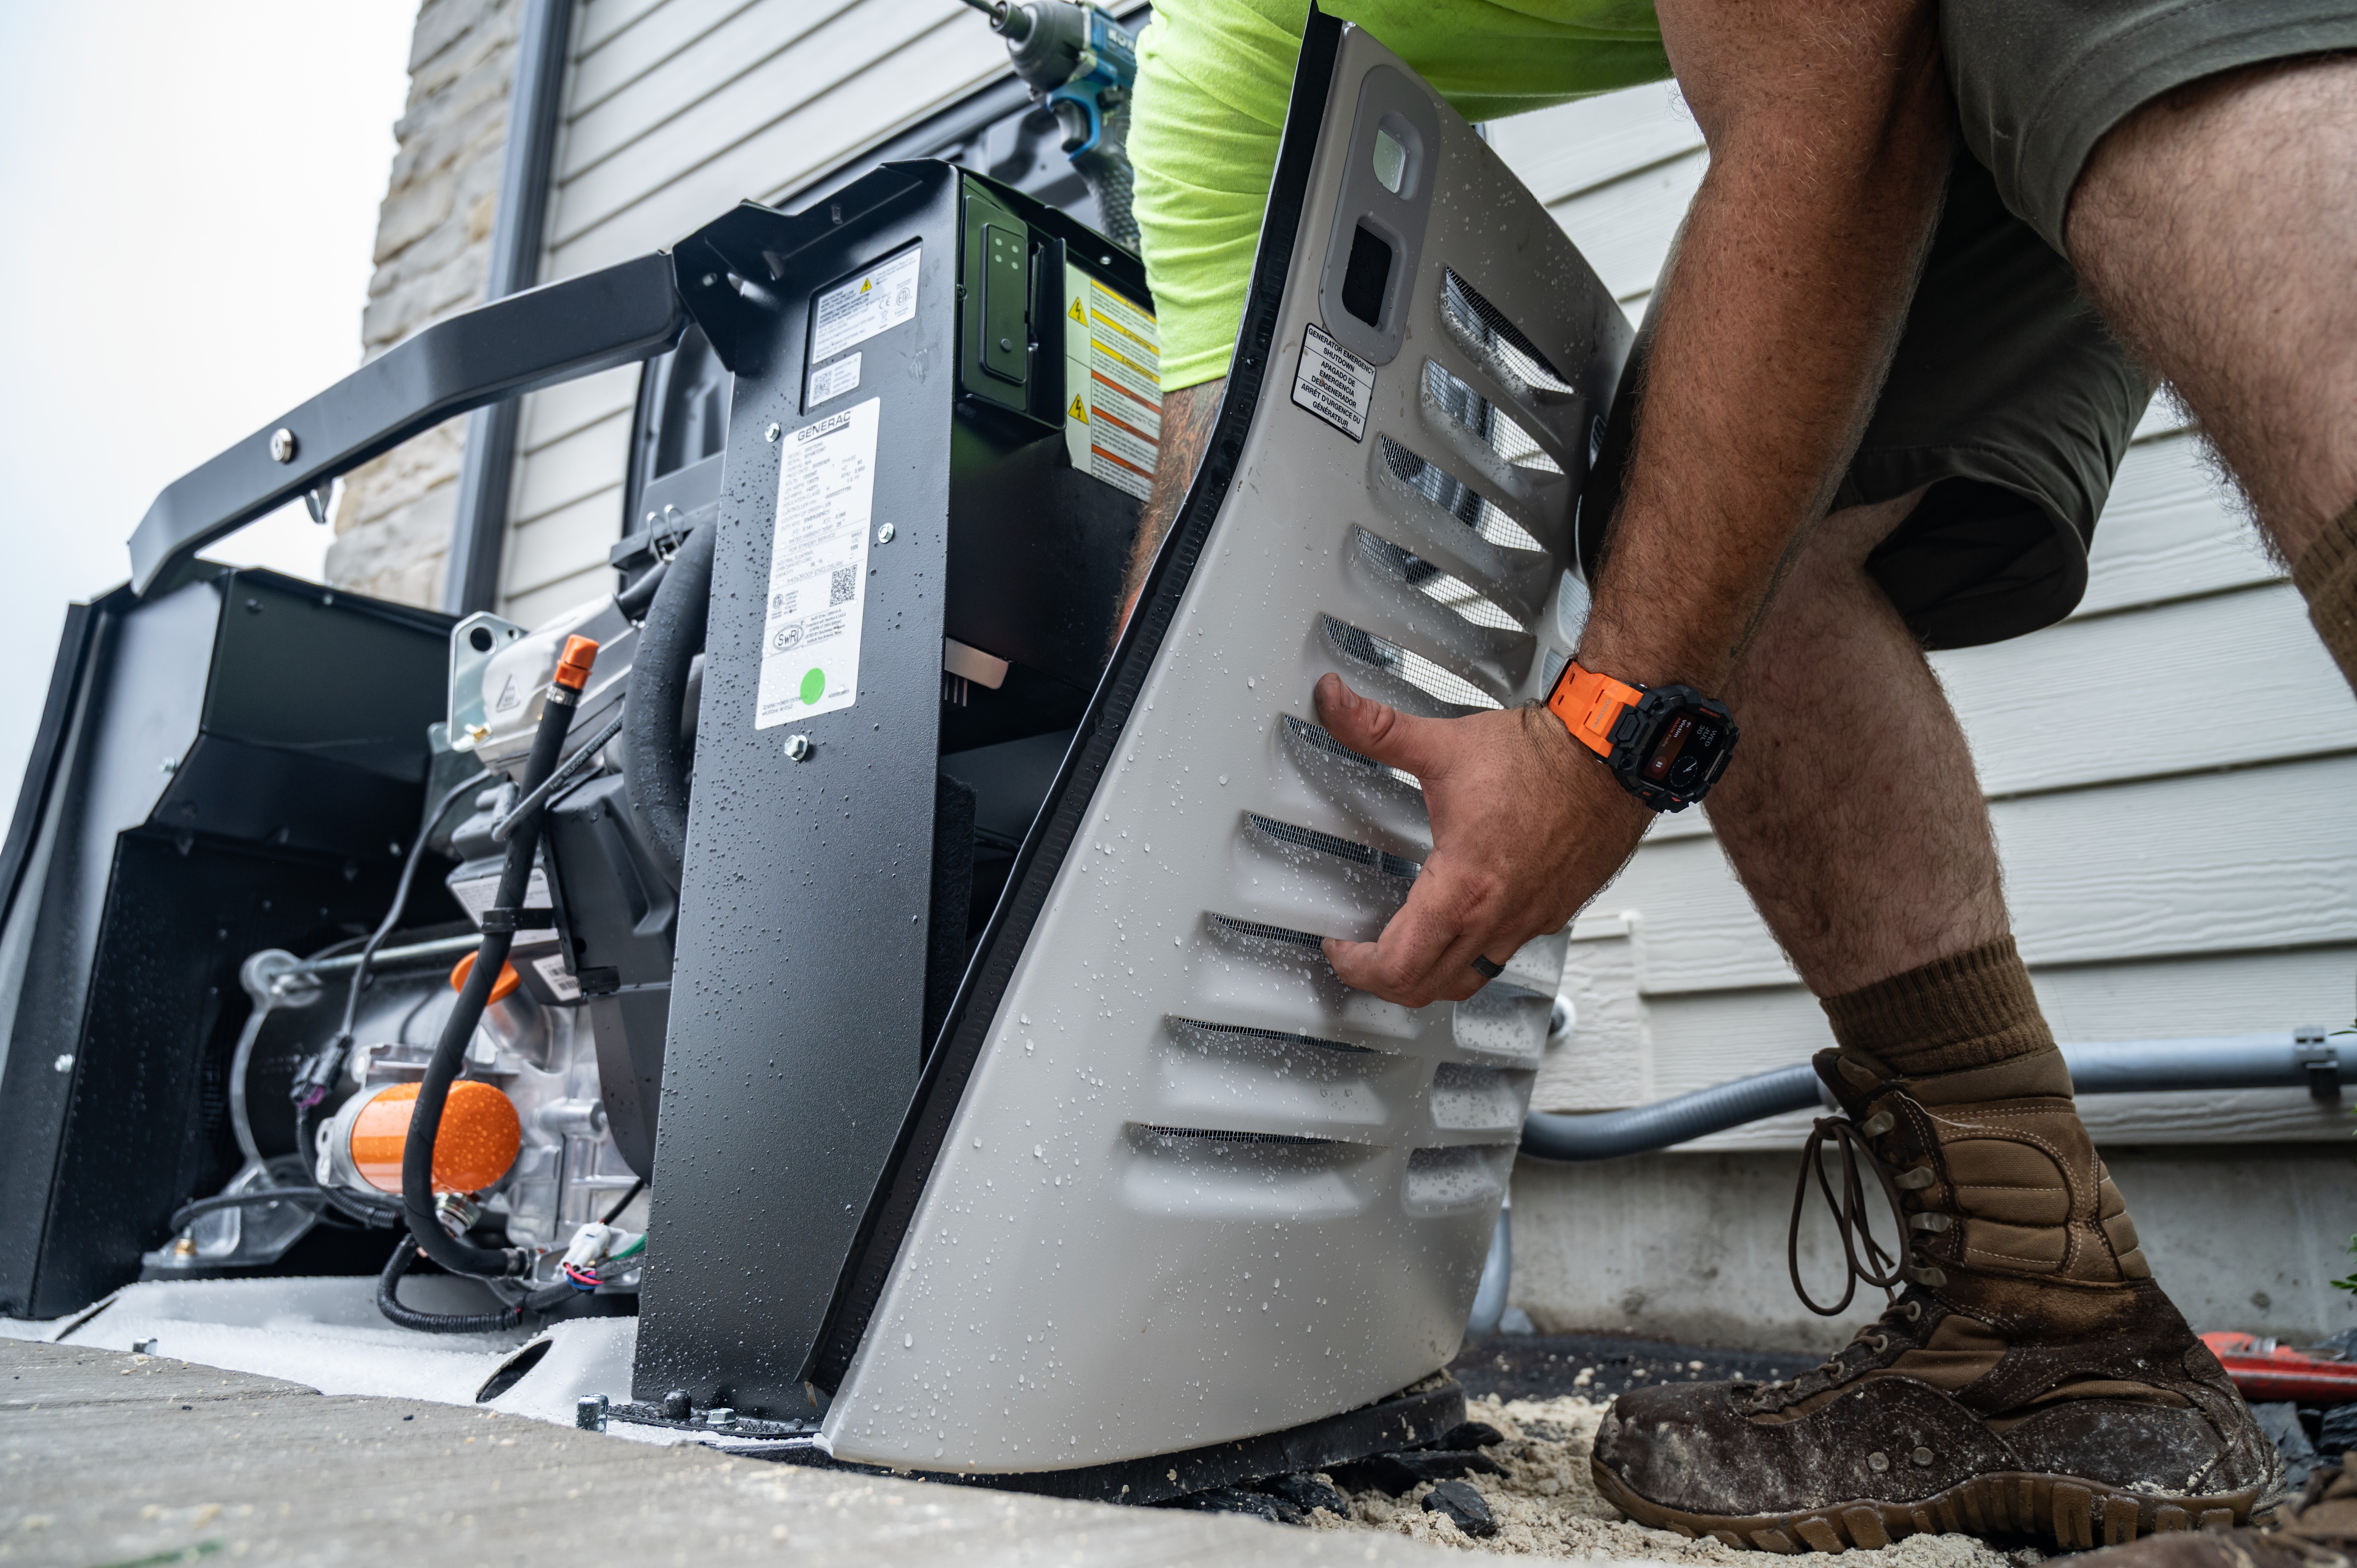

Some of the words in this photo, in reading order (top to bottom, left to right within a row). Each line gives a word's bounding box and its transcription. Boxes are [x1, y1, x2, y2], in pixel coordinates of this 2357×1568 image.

[1308, 327, 1343, 354] GENERATOR
[1342, 350, 1375, 376] EMERGENCY
[1323, 347, 1355, 373] SHUTDOWN
[1320, 360, 1348, 382] APAGADO
[1348, 378, 1355, 387] DE
[1311, 374, 1323, 387] DEL
[1323, 382, 1357, 409] GENERADOR
[1319, 369, 1355, 397] EMERGENCIA
[1301, 381, 1321, 400] ARRÊT
[1321, 394, 1353, 419] D'URGENCE
[1353, 415, 1360, 425] DU
[1312, 398, 1349, 428] GÉNÉRATEUR
[797, 410, 851, 442] GENERAC
[787, 457, 801, 466] SERIAL
[788, 450, 801, 459] MODEL
[842, 454, 856, 464] PHASE
[782, 513, 800, 524] COUNTRY
[804, 509, 830, 523] EMERGENCY
[799, 539, 817, 549] STANDBY
[818, 531, 836, 542] SERVICE
[803, 528, 820, 539] AMBIENT
[822, 524, 833, 532] TEMP
[795, 550, 813, 560] FLOATING
[815, 560, 843, 574] ENCLOSURE
[778, 627, 799, 647] SwRI
[1669, 716, 1681, 734] Abbie
[1673, 718, 1687, 739] Victim
[1696, 724, 1705, 735] 30
[1699, 726, 1711, 742] JUL
[1661, 733, 1671, 748] Falls
[1703, 729, 1717, 747] WED
[564, 752, 590, 777] SILICONE
